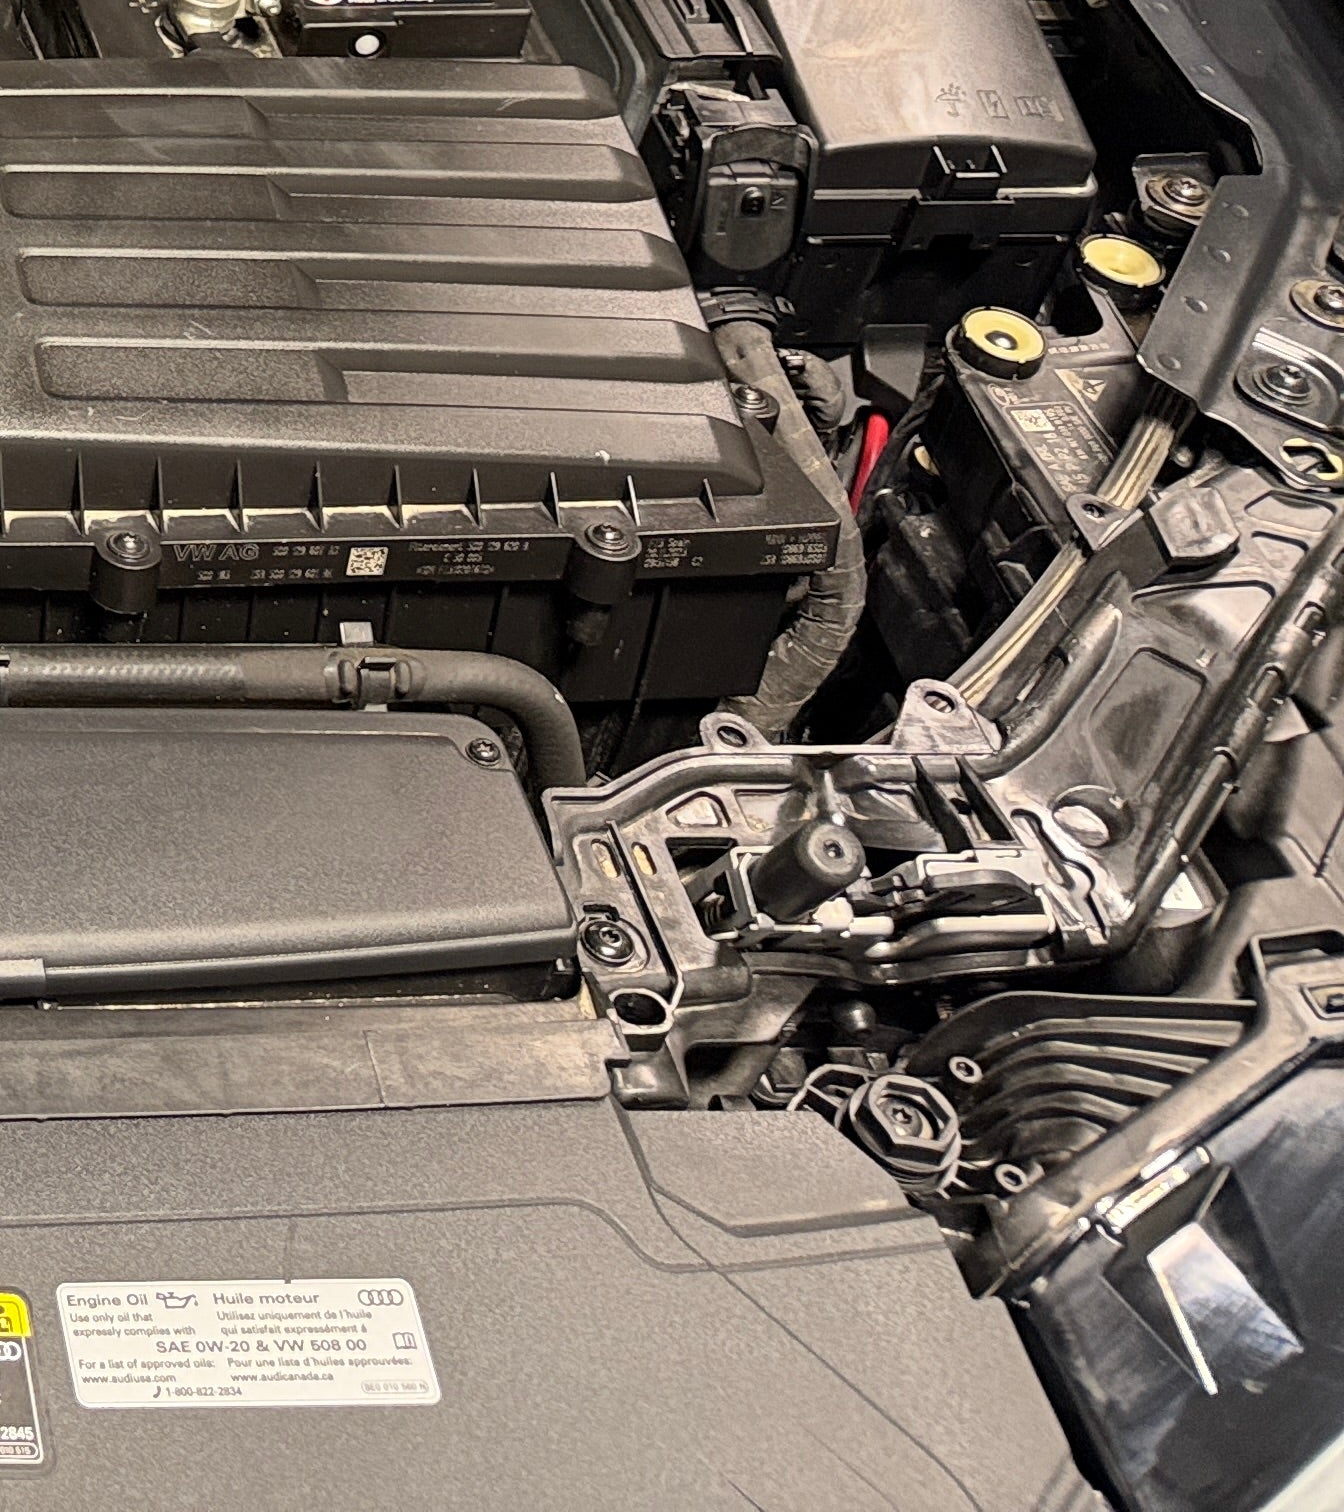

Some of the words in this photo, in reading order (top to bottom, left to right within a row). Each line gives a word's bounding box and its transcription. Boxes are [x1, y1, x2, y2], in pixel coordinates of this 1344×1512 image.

[174, 543, 217, 562] VW
[218, 543, 261, 561] AG
[66, 1294, 122, 1309] Engine
[126, 1293, 149, 1306] Oil
[213, 1292, 255, 1305] Huile
[259, 1293, 320, 1304] moteur
[69, 1313, 90, 1323] Use
[92, 1312, 115, 1324] only
[117, 1312, 131, 1322] oil
[132, 1313, 154, 1322] that
[216, 1311, 255, 1321] Utilisez
[258, 1311, 323, 1322] uniquement
[324, 1310, 338, 1320] de
[339, 1309, 373, 1320] l'huile
[73, 1327, 121, 1338] expressly
[124, 1326, 171, 1338] complies
[172, 1326, 196, 1335] with
[220, 1325, 238, 1336] qui
[240, 1324, 282, 1335] satisfait
[155, 1341, 192, 1353] SAE
[194, 1340, 250, 1353] 0W-20
[255, 1339, 270, 1353] &
[272, 1339, 306, 1352] VW
[310, 1338, 342, 1352] 508
[345, 1338, 368, 1351] 00
[78, 1359, 98, 1370] For
[107, 1359, 125, 1369] list
[126, 1359, 138, 1369] of
[140, 1358, 191, 1370] approved
[226, 1357, 253, 1367] Pour
[255, 1358, 276, 1367] une
[278, 1356, 301, 1367] liste
[80, 1373, 177, 1384] www.audiusa.com
[229, 1372, 335, 1383] www.audicanada.ca
[165, 1386, 243, 1397] 1-800-822-2834
